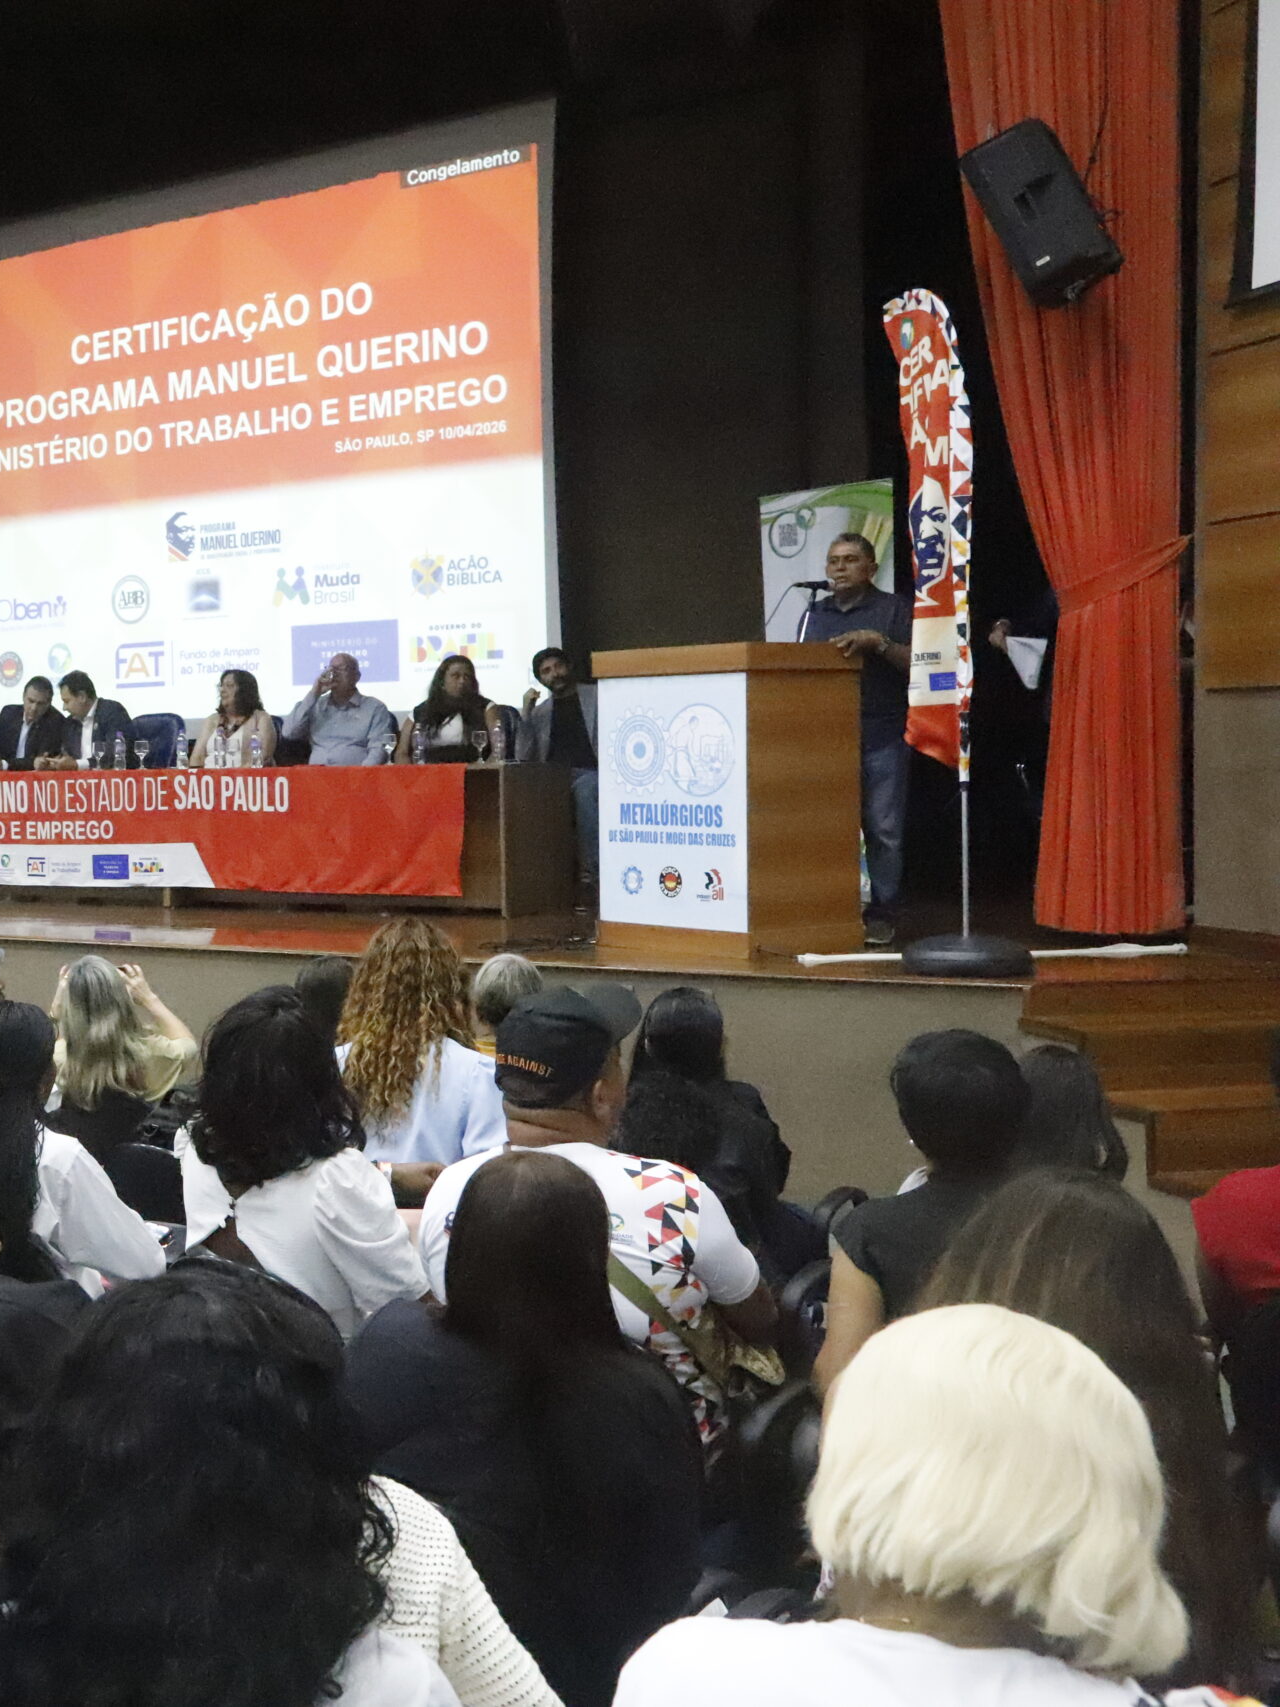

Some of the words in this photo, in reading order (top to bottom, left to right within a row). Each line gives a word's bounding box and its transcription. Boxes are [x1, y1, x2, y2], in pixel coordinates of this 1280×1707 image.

[407, 149, 520, 185] Congelamento
[71, 292, 310, 365] CERTIFICAÇÃO
[320, 281, 373, 321] DO
[167, 352, 307, 402] MANUEL
[316, 321, 489, 377] QUERINO
[115, 426, 153, 455] DO
[159, 402, 312, 449] TRABALHO
[320, 399, 339, 426] E
[348, 374, 508, 423] EMPREGO
[334, 437, 362, 453] SÃO
[416, 429, 435, 443] SP
[438, 420, 507, 441] 10/04/2026
[200, 534, 238, 551] MANUEL
[241, 529, 281, 547] QUERINO
[447, 555, 489, 572] AÇÃO
[315, 573, 361, 588] Muda
[314, 588, 356, 604] Brasil
[115, 642, 166, 680] FAT
[179, 650, 206, 660] Fundo
[209, 648, 220, 658] de
[223, 646, 260, 659] Amparo
[180, 665, 193, 675] ao
[33, 779, 59, 814] NO
[64, 777, 137, 813] ESTADO
[143, 776, 168, 812] DE
[174, 769, 215, 811] SÃO
[221, 775, 289, 813] PAULO
[620, 800, 723, 828] METALÚRGICOS
[11, 821, 21, 839] E
[26, 820, 114, 840] EMPREGO
[609, 830, 617, 842] DE
[619, 829, 634, 843] SÃO
[636, 830, 658, 844] PAULO
[660, 832, 664, 844] E
[666, 831, 687, 846] MOGI
[688, 833, 704, 846] DAS
[706, 834, 736, 848] CRUZES
[508, 1054, 554, 1078] AGAINST
